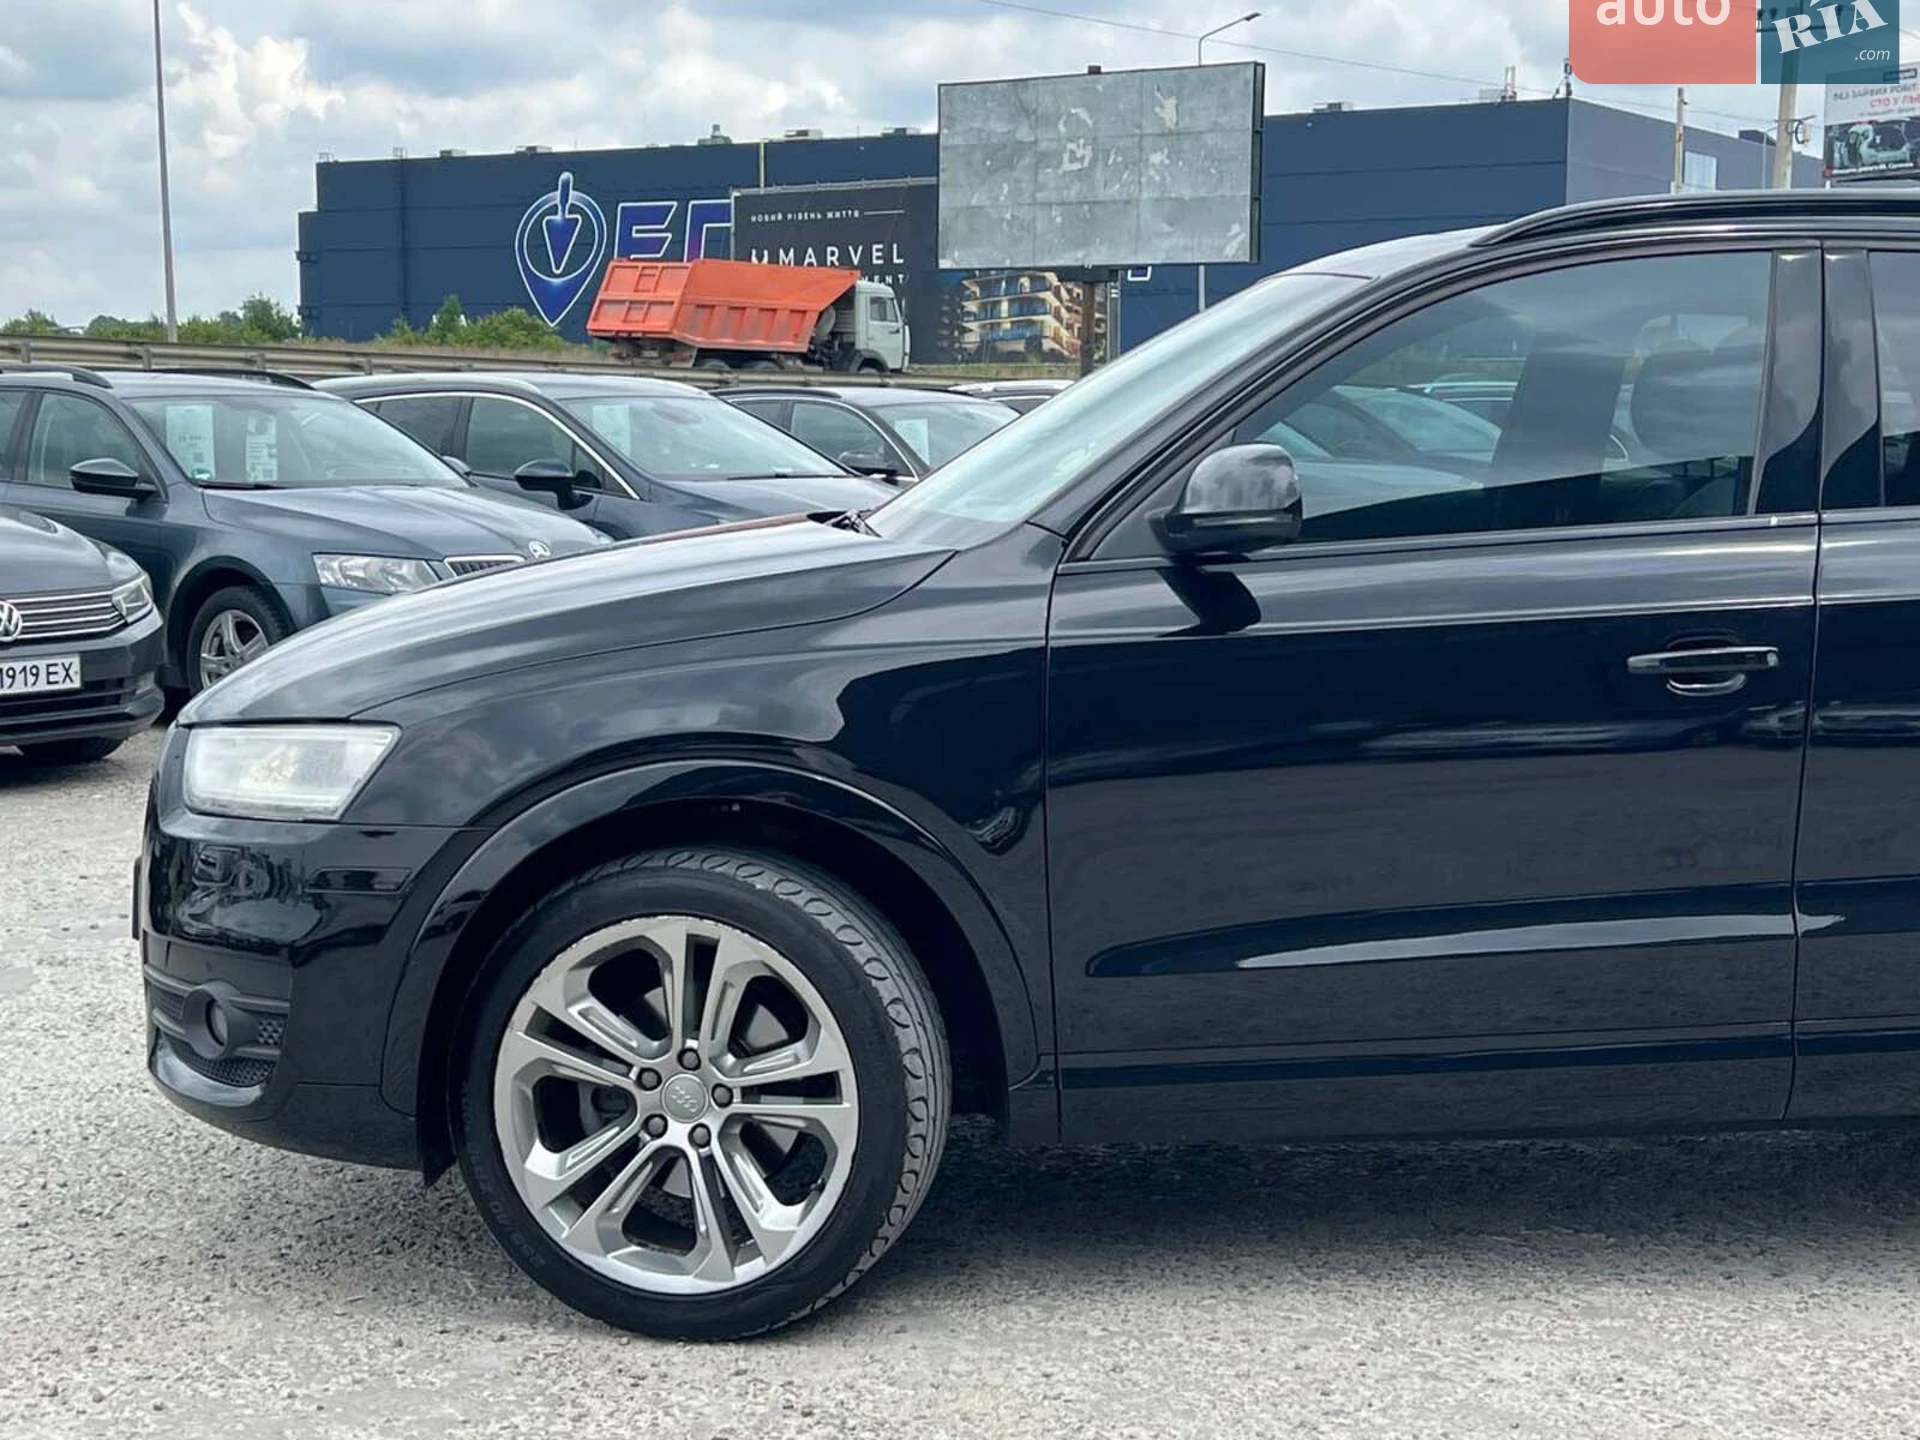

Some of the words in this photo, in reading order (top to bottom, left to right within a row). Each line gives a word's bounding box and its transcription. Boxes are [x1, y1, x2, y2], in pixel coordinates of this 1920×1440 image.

[751, 212, 783, 222] НОВИЙ
[786, 211, 822, 221] РІВЕНЬ
[778, 243, 905, 267] MARVEL
[0, 664, 40, 690] 1919
[46, 662, 74, 685] EX
